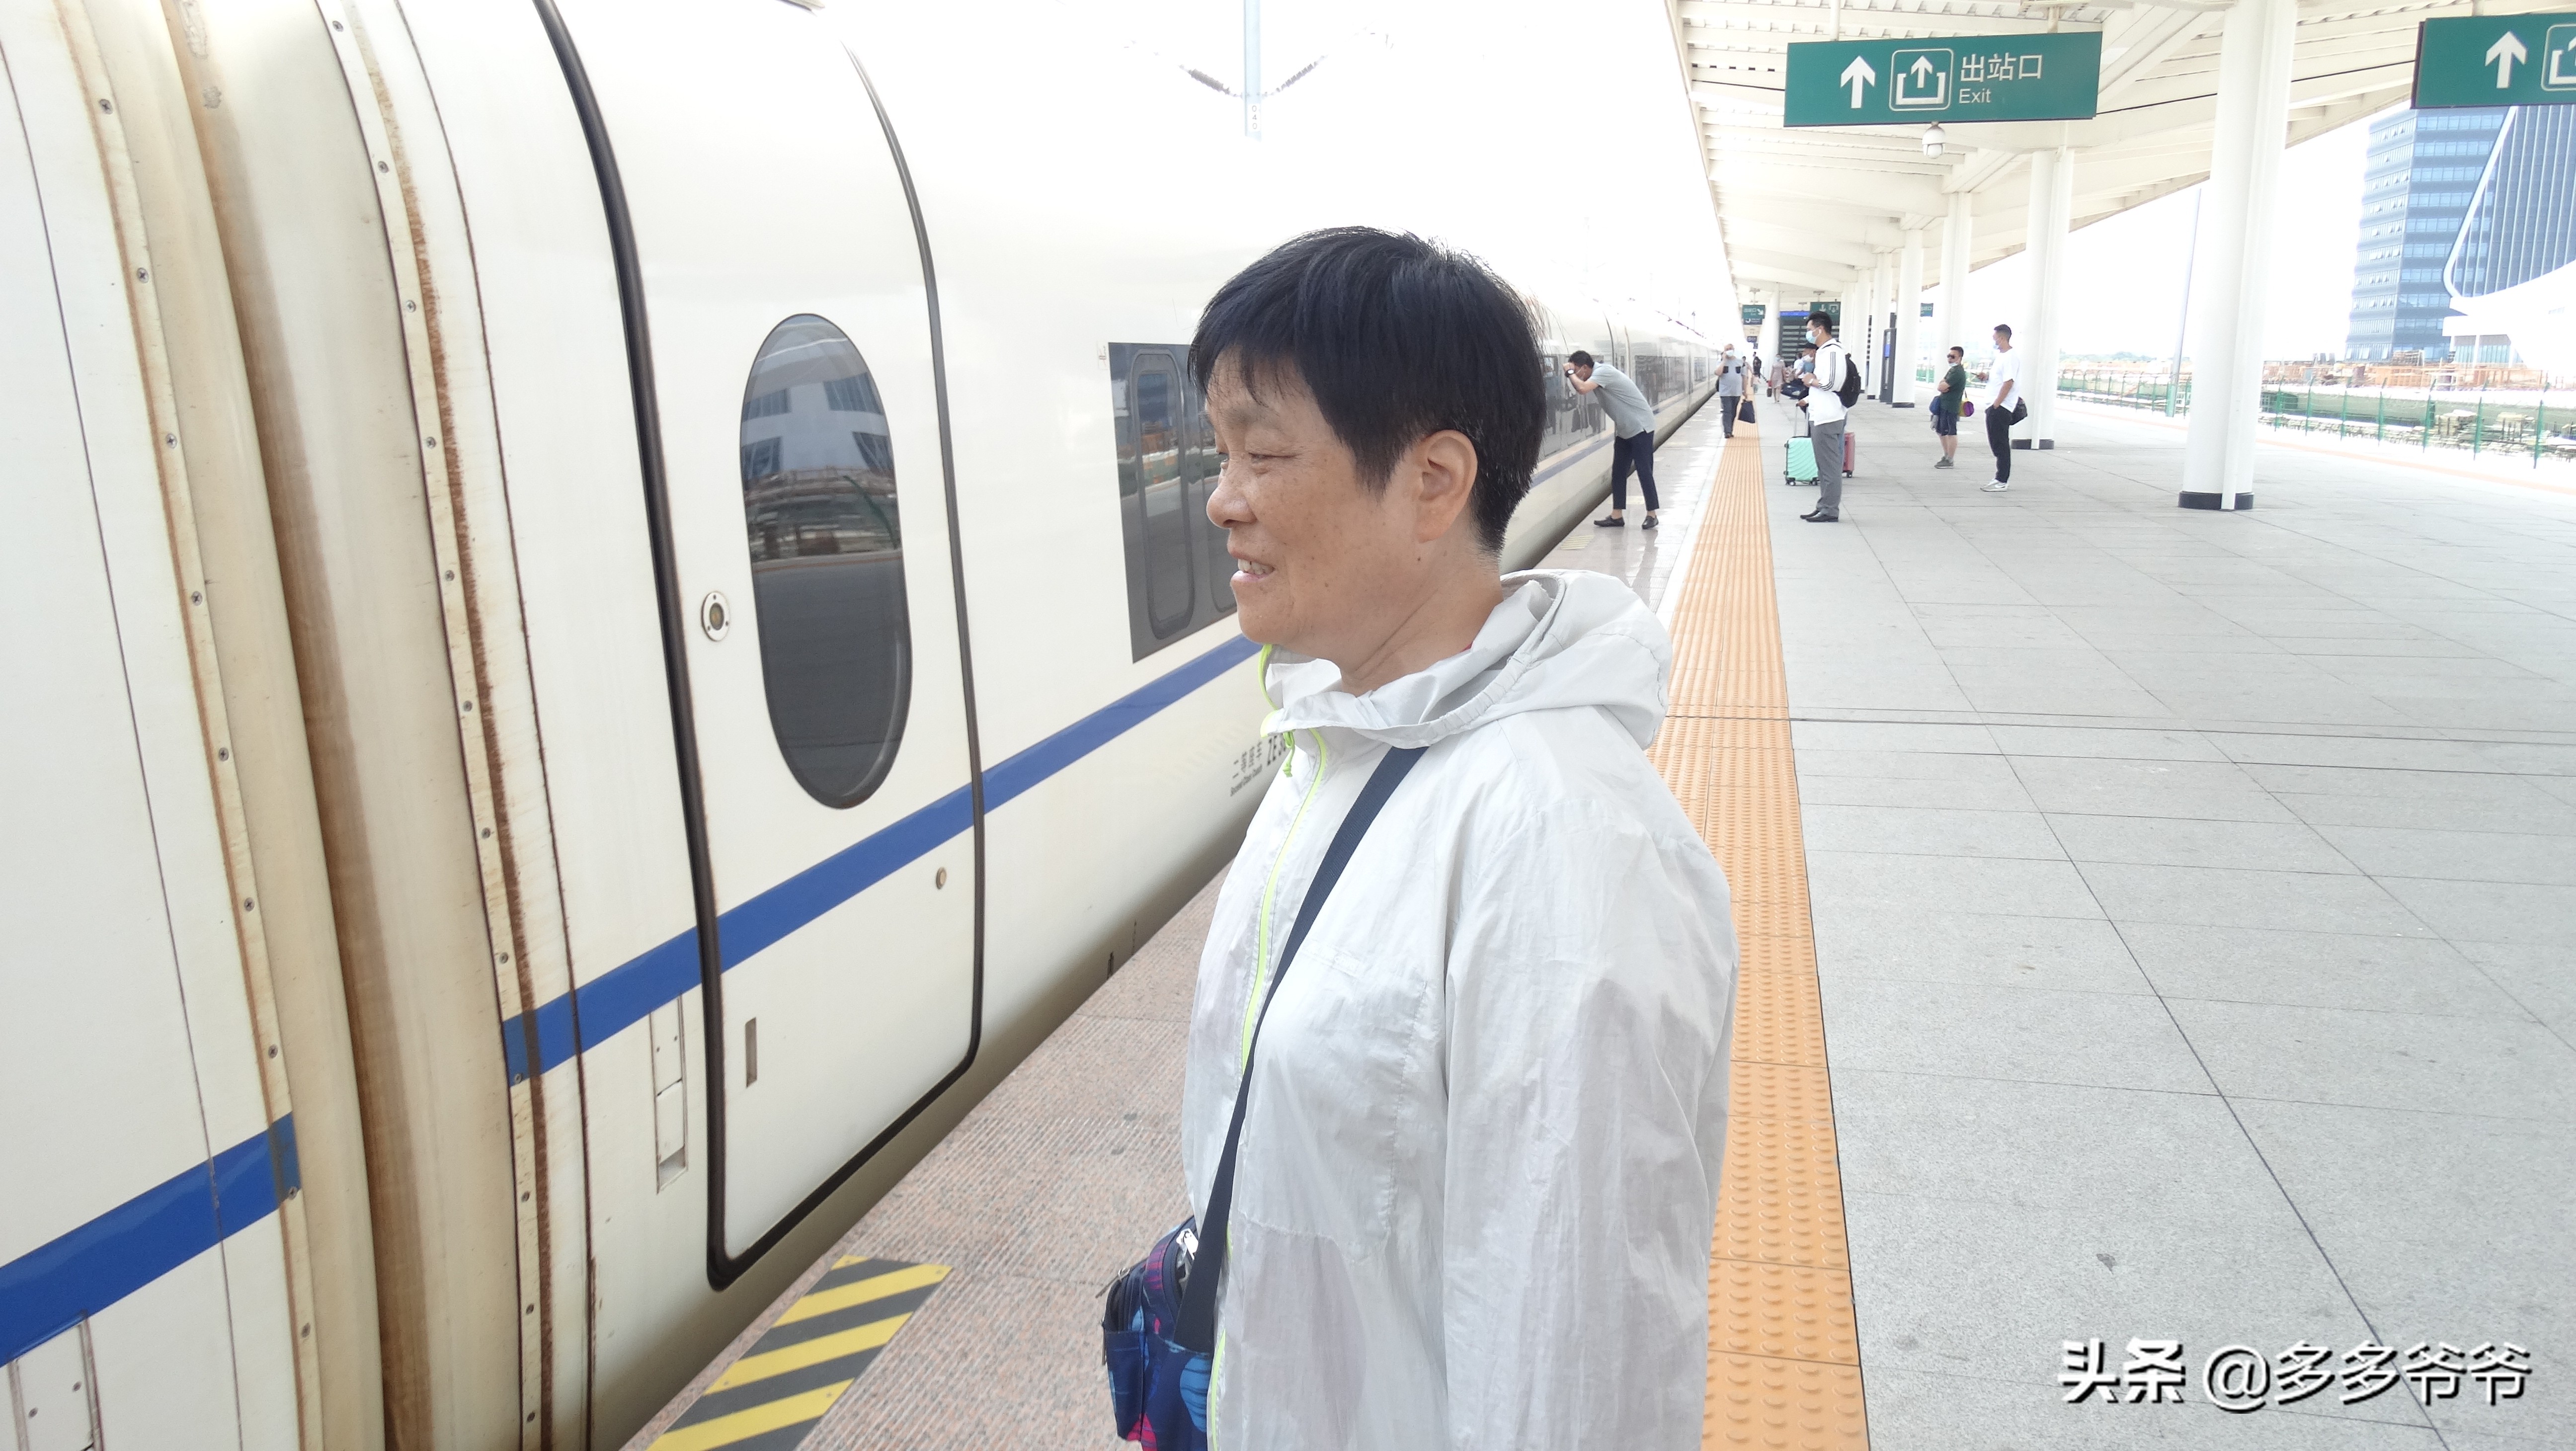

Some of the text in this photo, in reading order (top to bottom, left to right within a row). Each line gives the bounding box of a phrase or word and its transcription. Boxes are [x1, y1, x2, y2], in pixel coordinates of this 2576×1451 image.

[1960, 52, 2042, 82] 出站口
[1959, 88, 1992, 104] Exit
